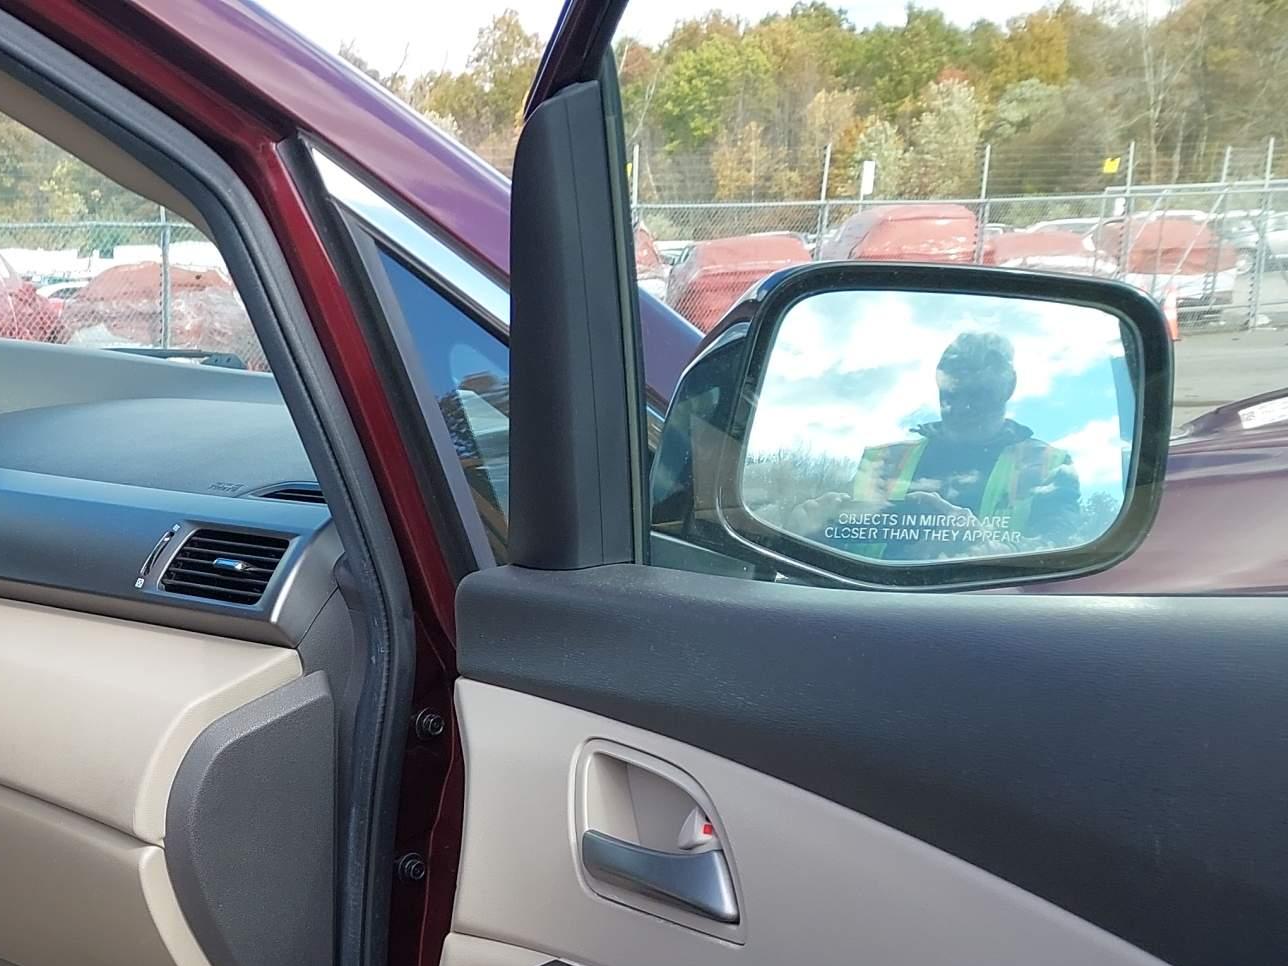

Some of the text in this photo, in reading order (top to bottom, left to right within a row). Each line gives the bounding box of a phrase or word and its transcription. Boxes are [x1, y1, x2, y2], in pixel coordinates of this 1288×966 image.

[838, 513, 1011, 528] OBJECTS IN MIRROR ARE
[824, 527, 1021, 543] CLOSER THAN THEY APPEAR
